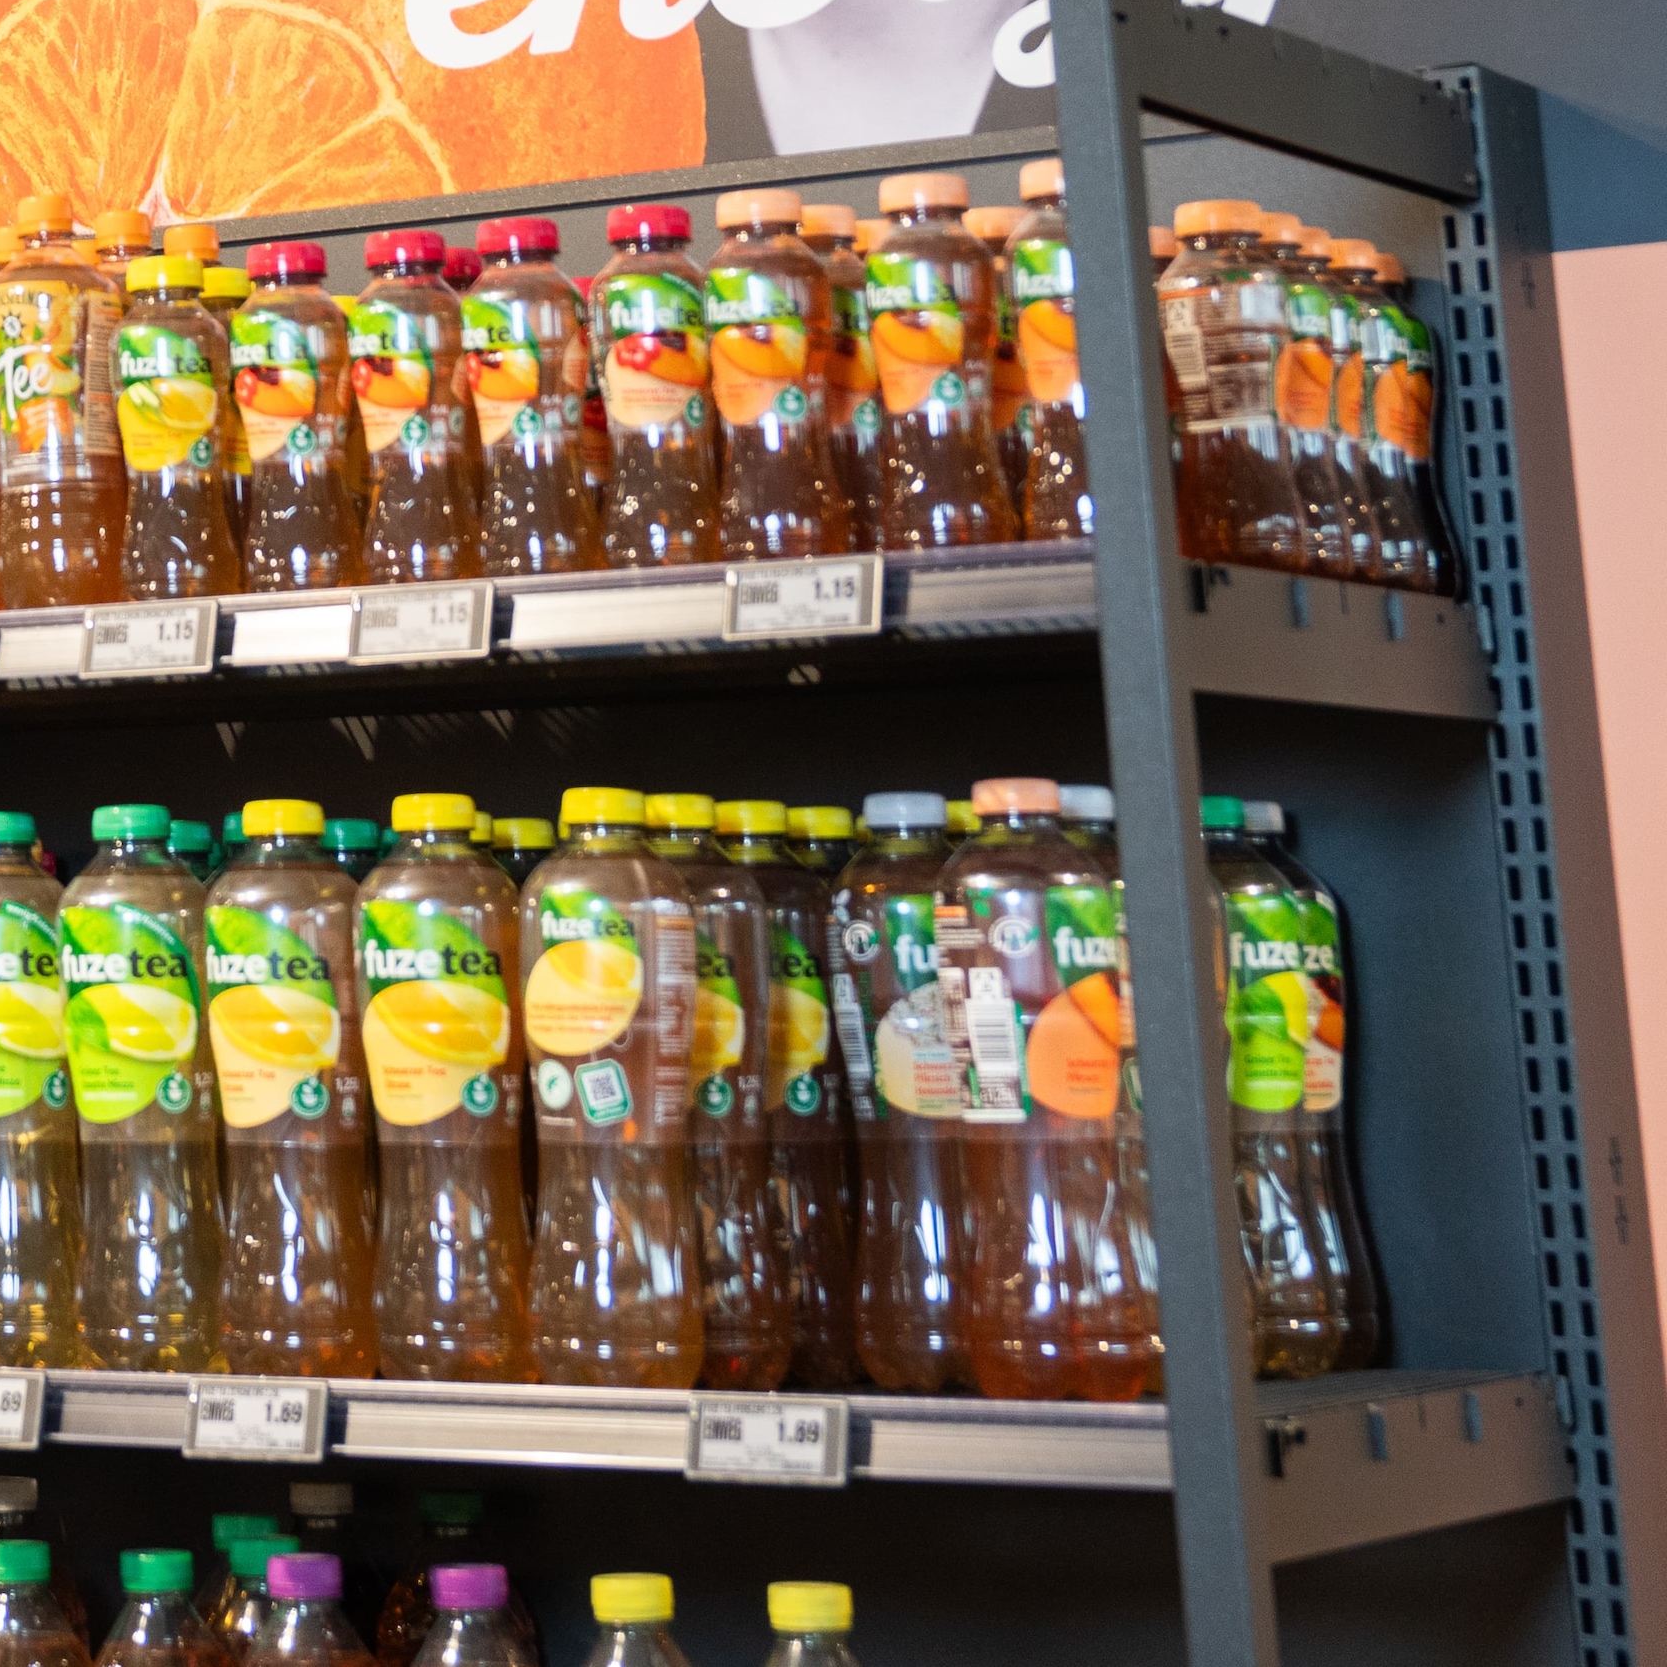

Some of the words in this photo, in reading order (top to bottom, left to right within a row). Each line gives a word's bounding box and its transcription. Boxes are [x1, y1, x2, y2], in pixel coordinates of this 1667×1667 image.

[813, 577, 857, 601] 1.15
[429, 604, 469, 626] 1.15
[156, 620, 194, 642] 1.15
[62, 945, 190, 983] fuzetea
[364, 938, 502, 980] fuzetea
[264, 1400, 304, 1425] 1.69
[776, 1419, 822, 1444] 1.69
